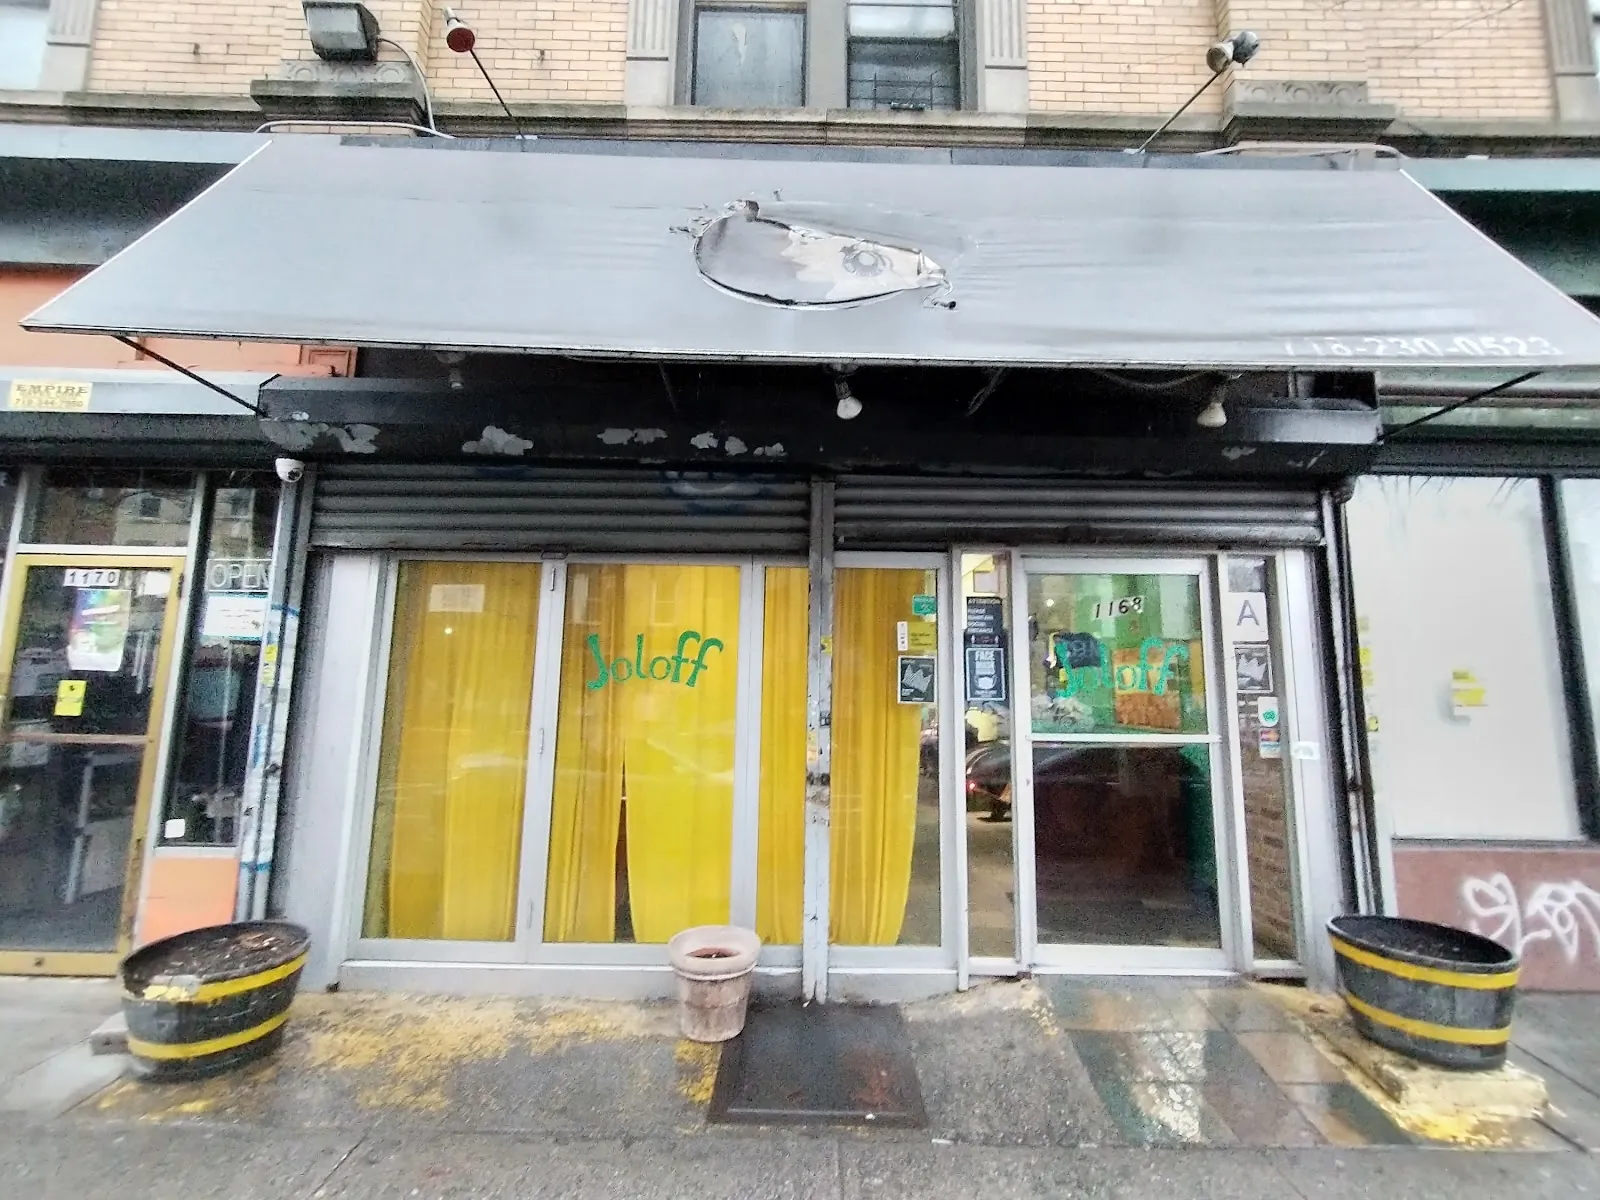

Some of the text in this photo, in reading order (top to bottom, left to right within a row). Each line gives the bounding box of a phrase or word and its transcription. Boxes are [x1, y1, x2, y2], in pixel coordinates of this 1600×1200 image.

[15, 384, 89, 394] EMPIRE
[69, 571, 116, 583] 1170
[1095, 596, 1143, 619] 1168
[1236, 600, 1260, 626] A
[586, 630, 724, 690] Joloff
[1053, 636, 1190, 698] Joloff
